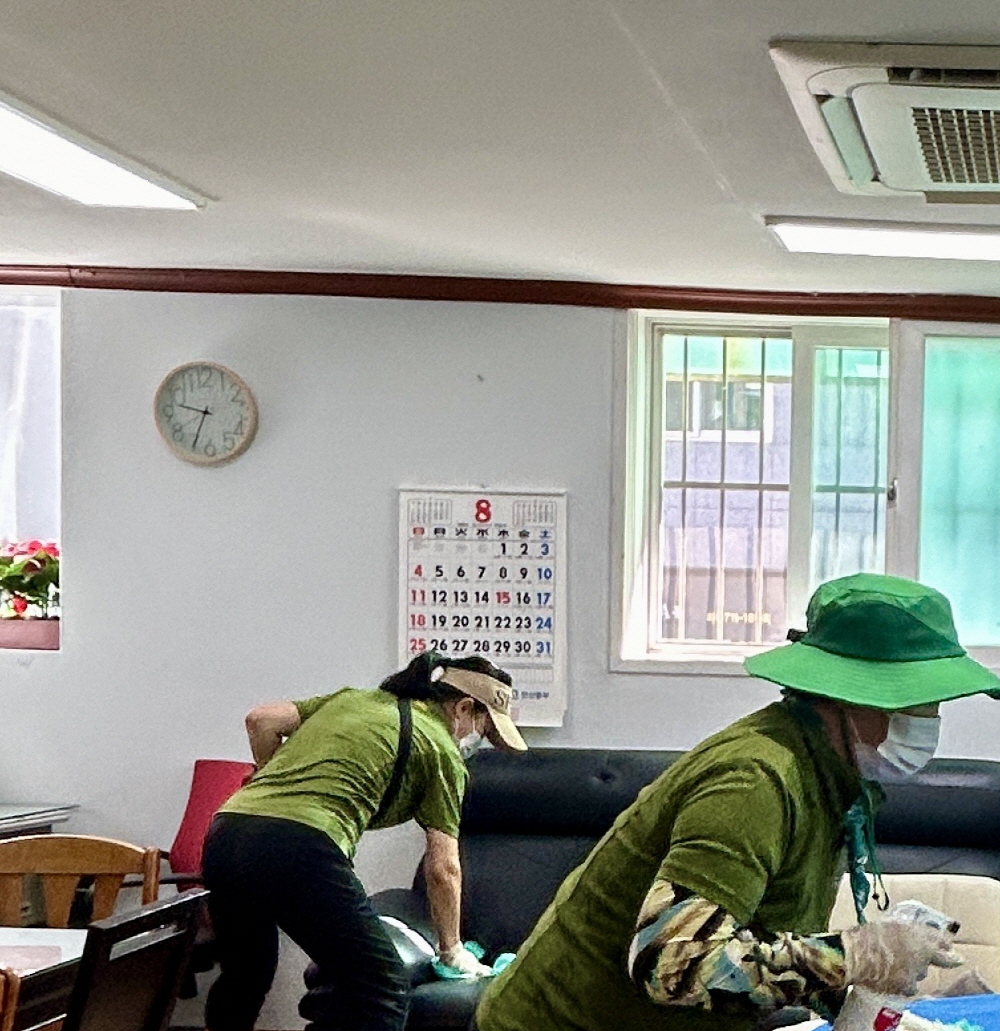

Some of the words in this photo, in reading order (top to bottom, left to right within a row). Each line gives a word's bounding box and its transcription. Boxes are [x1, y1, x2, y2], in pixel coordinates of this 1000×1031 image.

[197, 367, 213, 388] 12
[230, 383, 243, 402] 2
[172, 422, 184, 442] 8
[233, 414, 245, 435] 4
[204, 438, 216, 457] 6
[223, 431, 235, 451] 5
[475, 499, 491, 522] 8
[455, 528, 467, 536] 火
[476, 528, 489, 537] 水
[498, 528, 510, 539] 木
[518, 529, 530, 538] 金
[539, 529, 551, 539] 土
[501, 543, 506, 555] 1
[520, 543, 528, 555] 2
[541, 544, 550, 556] 3
[414, 564, 423, 577] 4
[435, 565, 444, 577] 5
[457, 565, 466, 578] 6
[477, 566, 486, 579] 7
[499, 566, 508, 579] 8
[519, 566, 528, 579] 9
[537, 567, 552, 580] 10
[411, 589, 426, 603] 11
[431, 590, 447, 603] 12
[453, 591, 468, 603] 13
[474, 591, 489, 604] 14
[496, 592, 511, 604] 15
[516, 592, 531, 605] 16
[536, 592, 551, 605] 17
[410, 614, 426, 626] 18
[432, 615, 447, 627] 19
[452, 615, 469, 627] 20
[474, 616, 489, 628] 21
[494, 616, 511, 628] 22
[515, 617, 532, 629] 23
[535, 617, 552, 629] 24
[410, 638, 426, 651] 25
[430, 639, 448, 651] 26
[452, 640, 468, 651] 27
[473, 640, 490, 652] 28
[494, 641, 511, 652] 29
[515, 641, 531, 652] 30
[536, 641, 551, 653] 31
